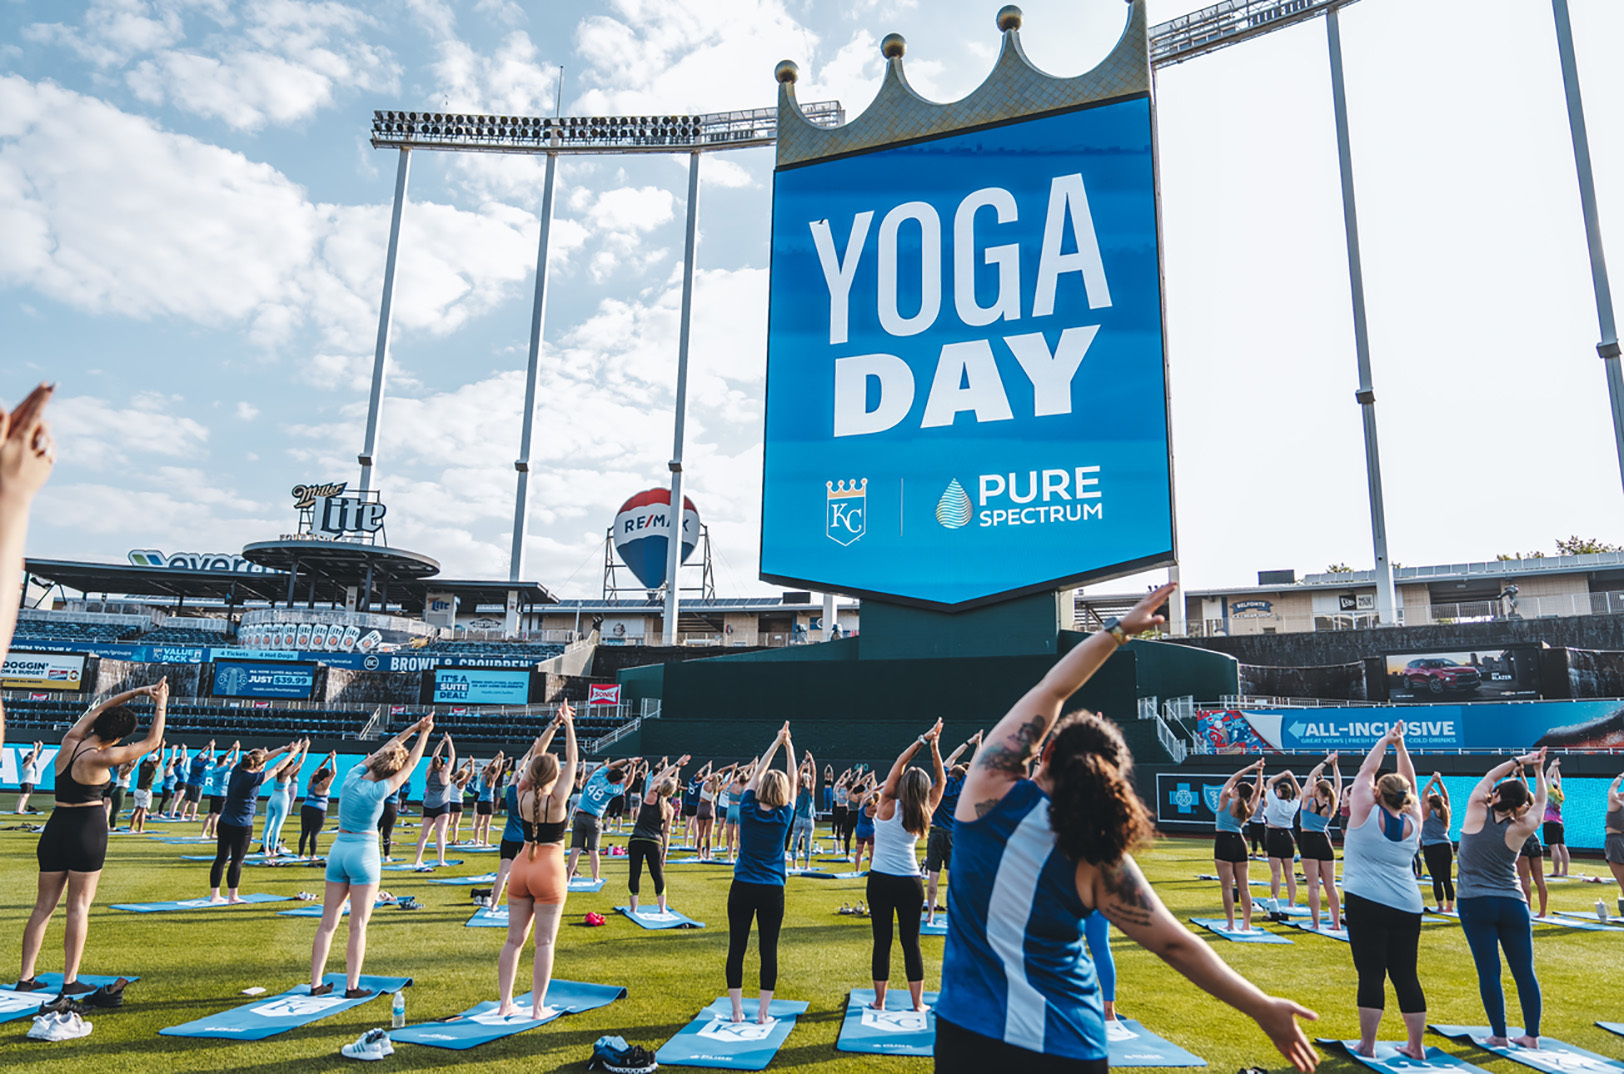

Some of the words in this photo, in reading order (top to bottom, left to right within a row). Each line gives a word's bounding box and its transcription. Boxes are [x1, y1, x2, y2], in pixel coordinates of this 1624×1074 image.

[809, 173, 1113, 345] YOGA
[833, 324, 1101, 438] DAY
[292, 484, 344, 507] Miller
[979, 465, 1102, 506] PURE
[307, 495, 386, 540] Lite
[624, 514, 689, 533] RE/MX
[830, 503, 862, 533] KC
[979, 502, 1103, 527] SPECTRUM
[249, 675, 272, 683] JUST
[274, 676, 308, 685] $39.99
[440, 683, 468, 691] SUITE
[594, 690, 615, 698] SONIC
[1305, 721, 1456, 736] ALL-INCLUSIVE
[587, 784, 605, 801] 48
